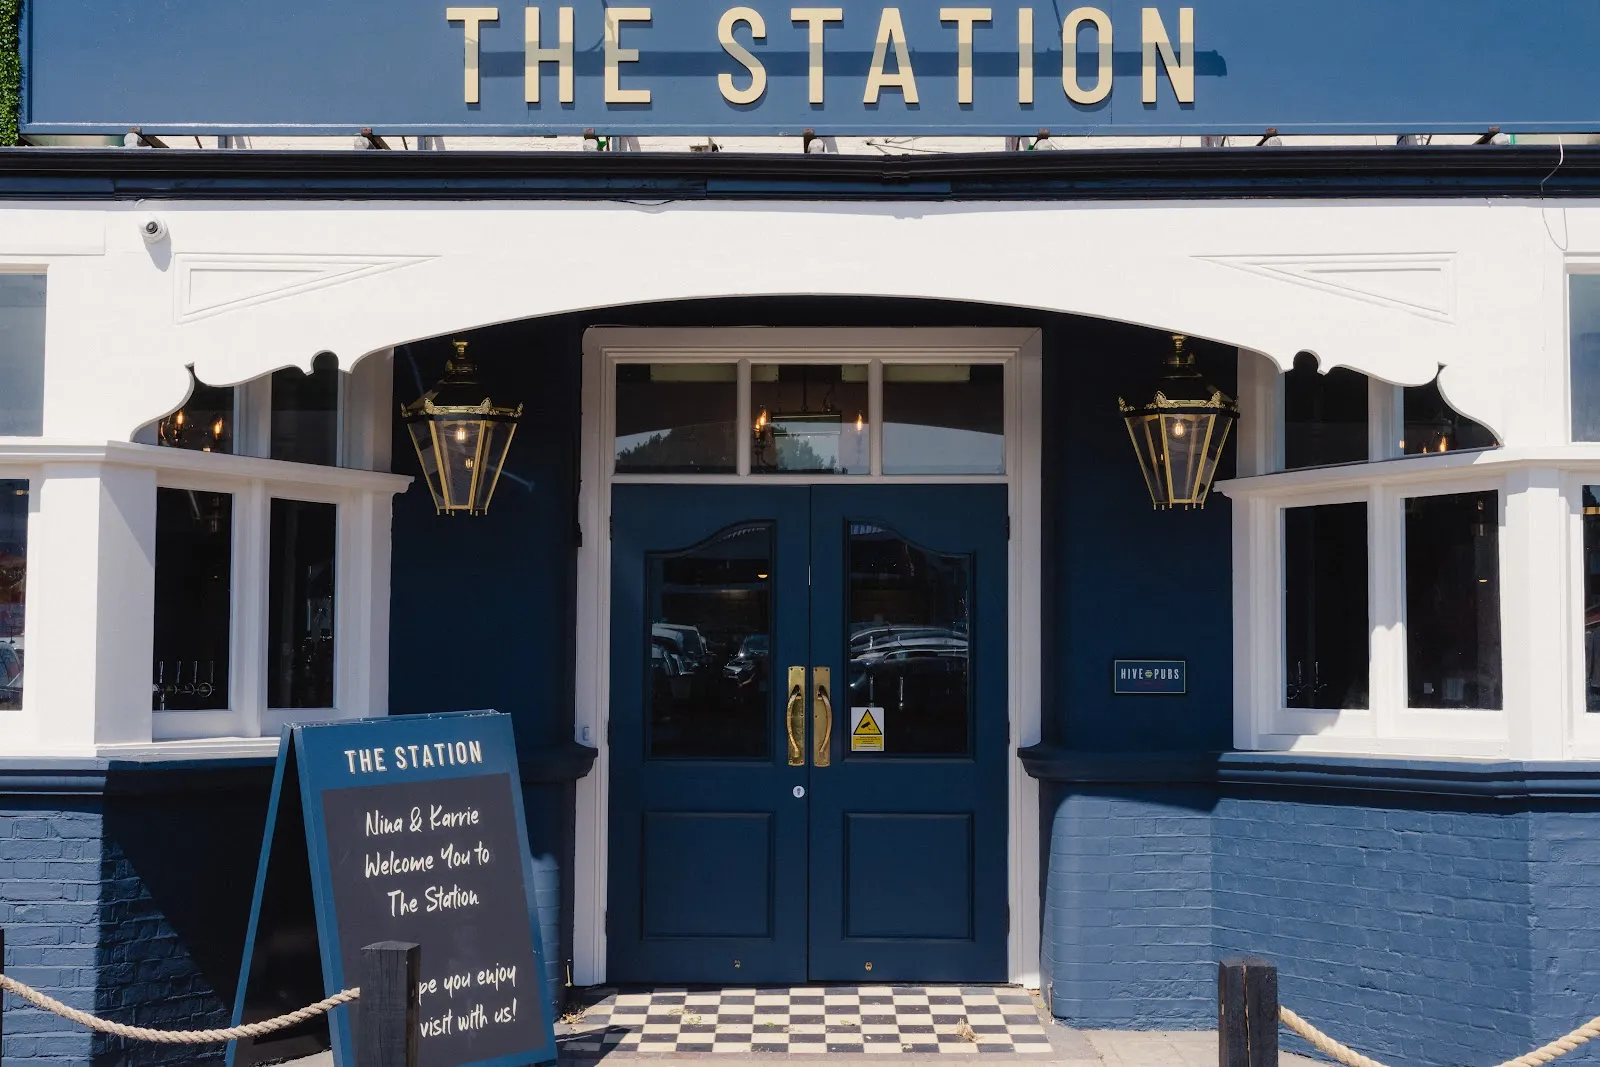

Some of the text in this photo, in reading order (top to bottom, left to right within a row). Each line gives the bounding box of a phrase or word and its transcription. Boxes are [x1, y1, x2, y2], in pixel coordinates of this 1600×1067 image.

[446, 6, 1195, 105] THE STATION
[1120, 668, 1180, 680] HIVE PUBS
[344, 740, 483, 774] THE STATION
[365, 804, 480, 837] Nina & Karrie
[364, 840, 490, 879] Welcome You to
[386, 883, 480, 918] The Station
[418, 962, 517, 1006] pe you enjoy
[419, 997, 517, 1038] visit with us!
